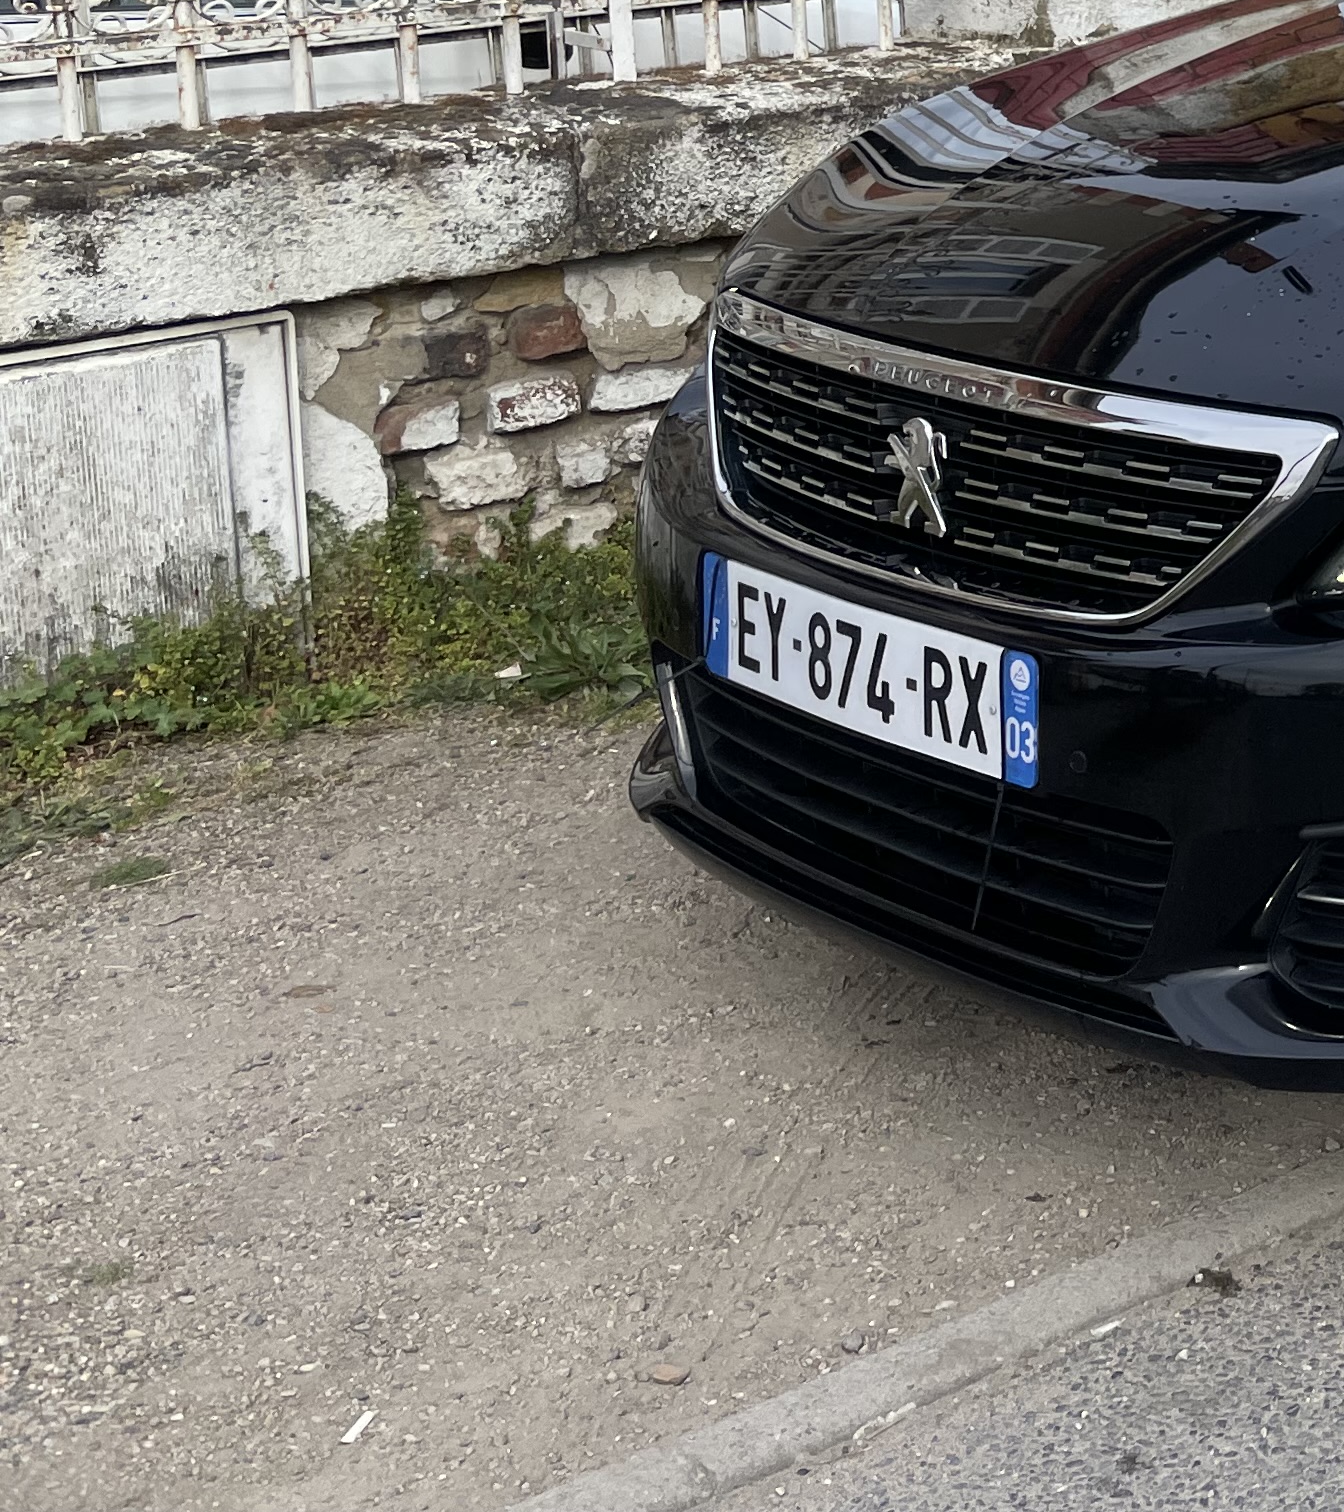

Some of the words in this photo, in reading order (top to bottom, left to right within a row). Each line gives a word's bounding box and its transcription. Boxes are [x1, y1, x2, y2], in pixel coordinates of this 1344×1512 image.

[874, 361, 992, 403] PEUGEOT
[712, 616, 721, 641] F
[737, 581, 989, 755] EY-874-RX
[1005, 716, 1036, 764] 03
